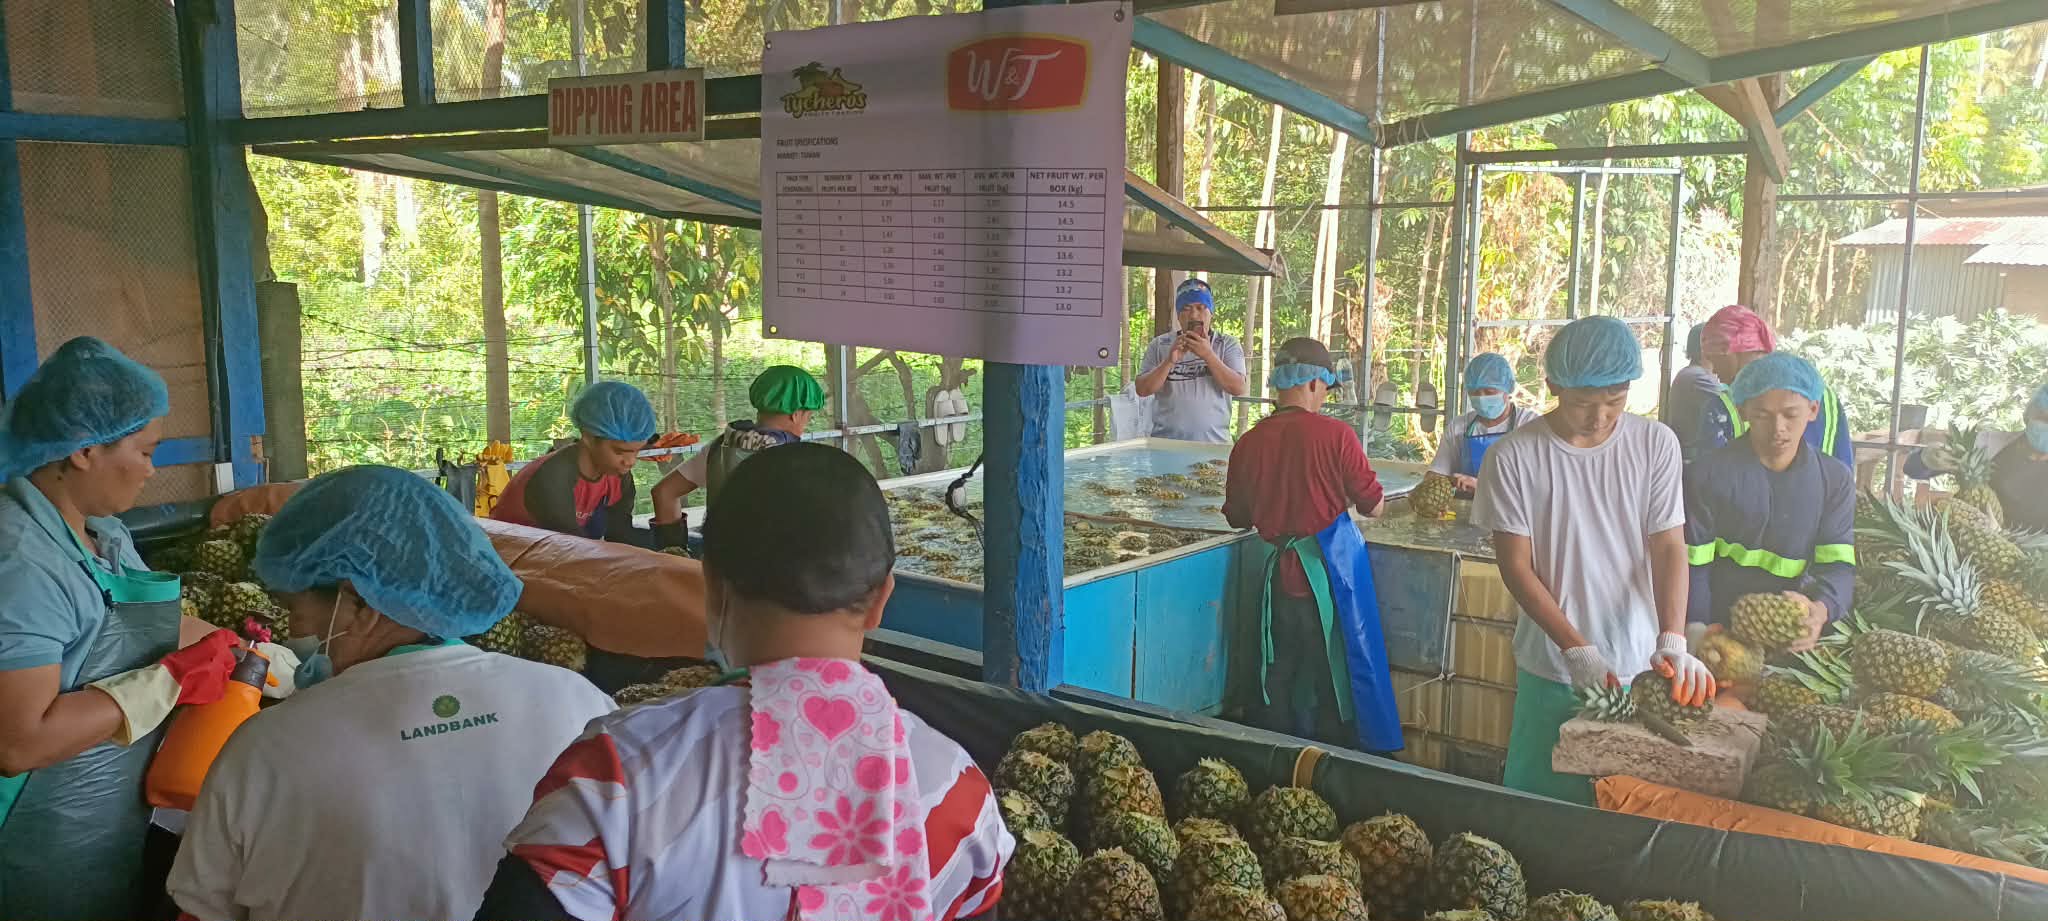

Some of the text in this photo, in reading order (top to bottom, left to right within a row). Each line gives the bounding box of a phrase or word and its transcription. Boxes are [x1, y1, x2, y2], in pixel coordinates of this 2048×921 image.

[552, 80, 697, 136] DIPPING AREA
[1030, 172, 1104, 180] NET FRUIT WT. PER
[1050, 184, 1083, 194] BOX (kg)
[1058, 200, 1075, 209] 14.5
[1057, 217, 1075, 226] 14.5
[1055, 303, 1072, 311] 13.0
[400, 712, 499, 741] LANDBANK
